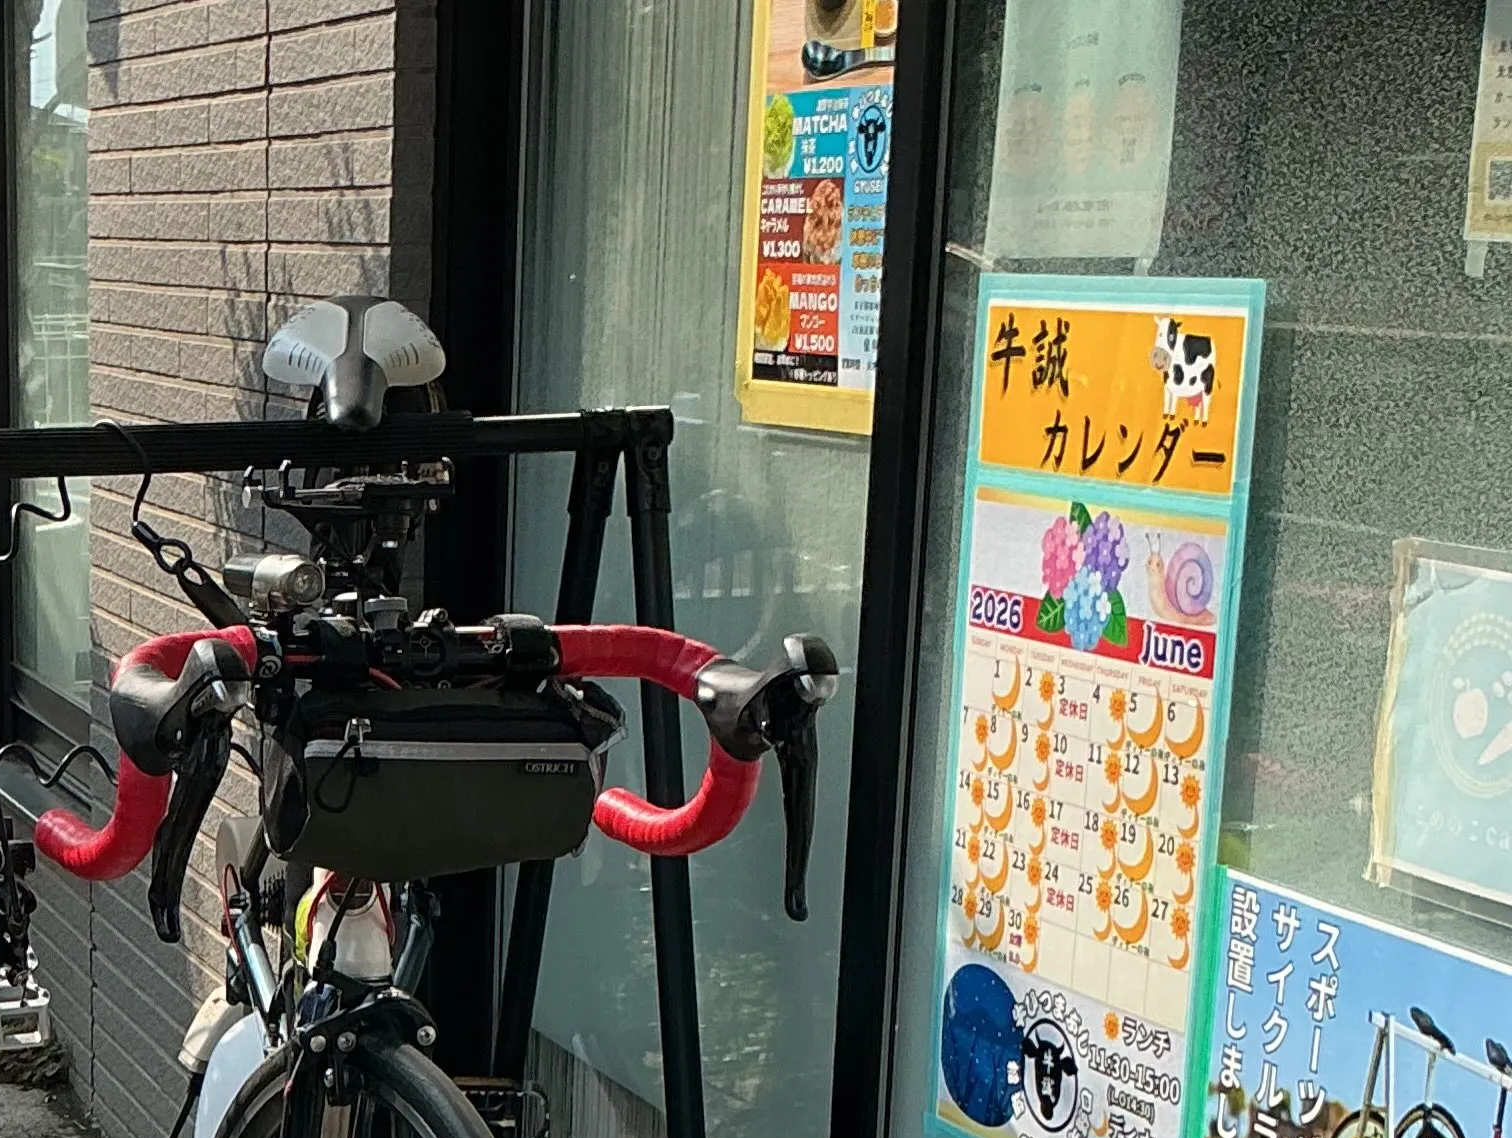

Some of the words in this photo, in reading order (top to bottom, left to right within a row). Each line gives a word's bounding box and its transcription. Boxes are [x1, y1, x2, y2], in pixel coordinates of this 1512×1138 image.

[792, 113, 848, 135] MATCHA
[803, 156, 843, 174] ¥1,200
[760, 197, 813, 214] CARAMEL
[762, 240, 801, 258] ¥1,300
[789, 292, 838, 312] MANGO
[794, 333, 835, 352] ¥1,500
[989, 313, 1072, 399] 牛誠
[1040, 409, 1227, 483] カレンダー
[970, 589, 1023, 632] 2026
[1141, 624, 1203, 669] June
[994, 660, 1000, 678] 1
[1025, 668, 1033, 686] 2
[1058, 675, 1065, 695] 3
[1093, 685, 1101, 703] 4
[1059, 699, 1088, 721] 定休日
[1129, 693, 1137, 713] 5
[1167, 702, 1176, 722] 6
[963, 706, 969, 724] 7
[990, 715, 997, 733] 8
[1022, 724, 1029, 742] 9
[1054, 734, 1068, 754] 10
[1088, 744, 1102, 764] 11
[1055, 759, 1084, 783] 定休日
[1124, 754, 1140, 775] 12
[1163, 764, 1179, 785] 13
[959, 770, 971, 791] 14
[987, 780, 999, 800] 15
[1017, 790, 1030, 810] 16
[1049, 800, 1063, 820] 17
[1084, 811, 1099, 832] 18
[955, 829, 967, 849] 21
[1050, 827, 1080, 852] 定休日
[1121, 822, 1136, 844] 19
[982, 840, 996, 860] 22
[1158, 834, 1175, 856] 20
[1012, 851, 1026, 871] 23
[1044, 862, 1059, 882] 24
[1078, 873, 1093, 895] 25
[952, 885, 963, 906] 28
[1046, 887, 1075, 912] 定休日
[1114, 886, 1129, 908] 26
[978, 897, 992, 918] 29
[1152, 899, 1169, 921] 27
[1008, 909, 1022, 930] 30
[1121, 1017, 1171, 1059] ランチ
[1088, 1044, 1181, 1105] 11:30-15:00
